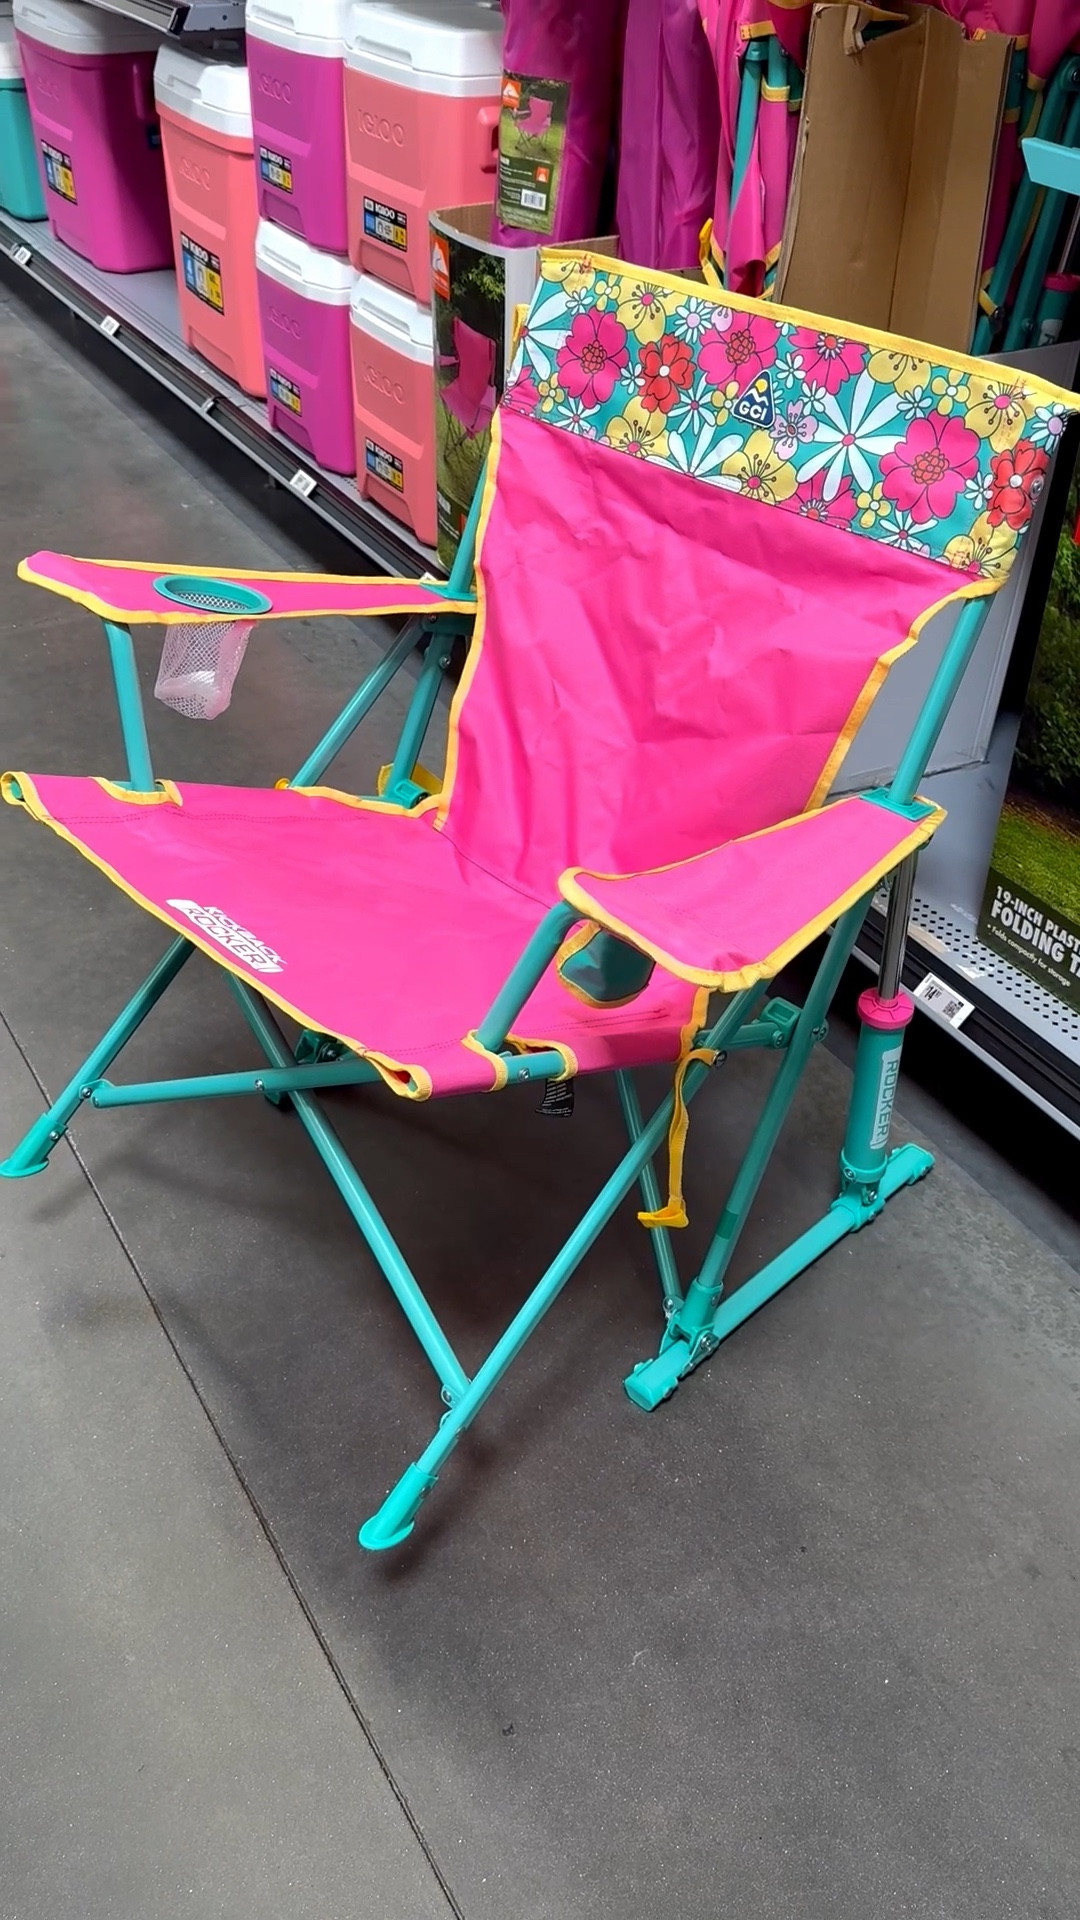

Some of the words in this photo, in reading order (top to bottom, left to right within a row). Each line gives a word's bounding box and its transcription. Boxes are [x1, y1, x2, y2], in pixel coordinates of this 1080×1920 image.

[357, 108, 405, 148] IGLOO
[738, 400, 768, 421] GCI
[184, 907, 268, 964] ROCKER
[202, 905, 288, 966] KICKBACK
[991, 899, 1065, 963] FOLDING
[1069, 952, 1080, 978] T
[996, 885, 1043, 927] 19-INCH
[1044, 918, 1080, 955] PLAST
[1007, 938, 1038, 964] compactly
[1037, 956, 1048, 970] for
[1047, 966, 1071, 987] storage
[876, 1059, 899, 1137] ROCKER
